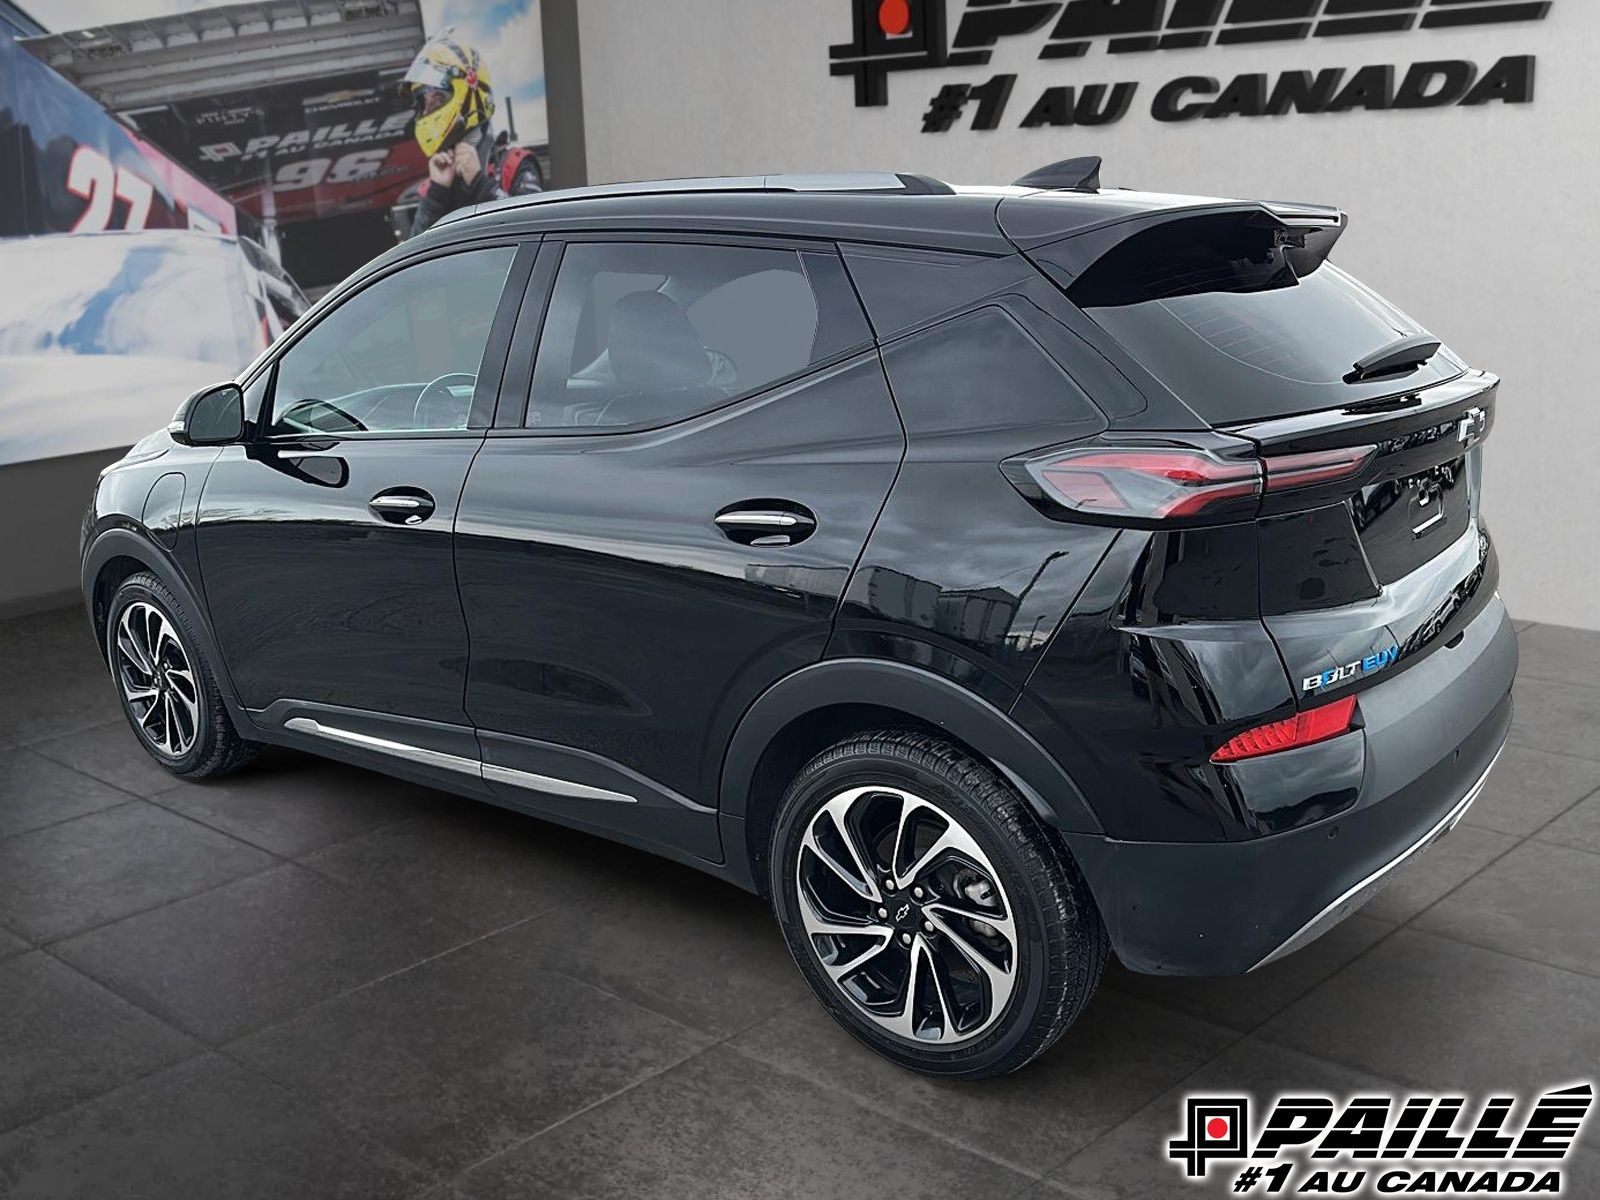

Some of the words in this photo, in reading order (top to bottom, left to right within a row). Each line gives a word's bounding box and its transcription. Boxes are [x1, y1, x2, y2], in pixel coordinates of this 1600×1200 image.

[921, 74, 1017, 133] #1
[1018, 82, 1139, 128] AU
[1150, 55, 1536, 122] CANADA
[67, 145, 154, 235] 27
[273, 149, 389, 192] 96
[1303, 661, 1361, 691] BOLT
[1361, 644, 1399, 672] EUV
